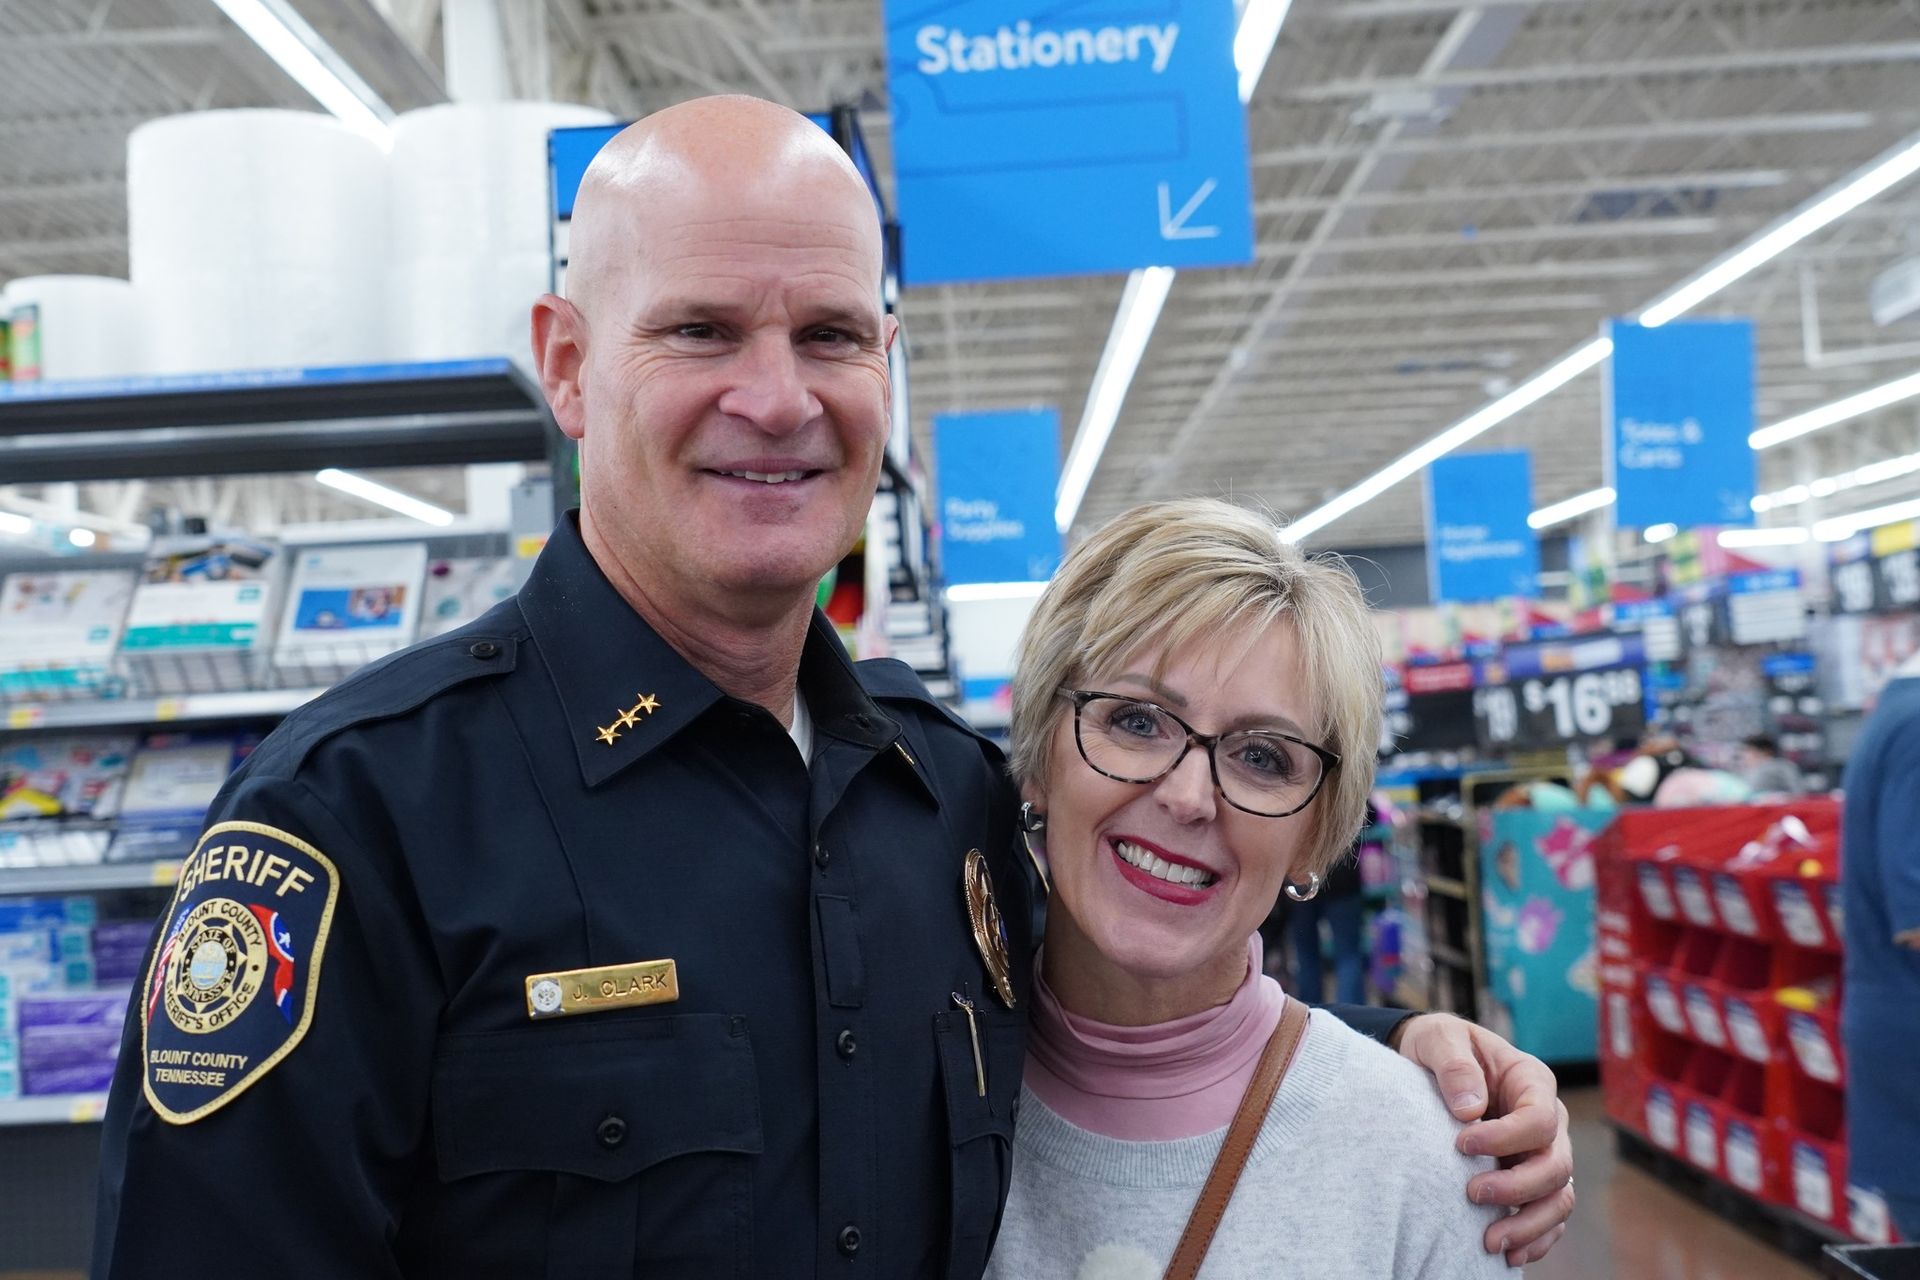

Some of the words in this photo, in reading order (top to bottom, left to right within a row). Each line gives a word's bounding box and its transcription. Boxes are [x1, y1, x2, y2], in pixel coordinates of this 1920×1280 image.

[915, 20, 1180, 75] Stationery
[180, 845, 315, 902] SHERIFF
[178, 901, 217, 943] BLOUNT
[220, 902, 262, 946] COUNTY
[191, 928, 222, 953] STATE
[223, 936, 236, 956] OF
[165, 978, 204, 1031] SHERIFF'S
[208, 981, 256, 1027] OFFICE
[572, 983, 589, 1001] J.
[600, 973, 669, 998] CLARK
[150, 1049, 192, 1066] BLOUNT
[191, 1051, 249, 1070] COUNTY
[155, 1067, 226, 1087] TENNESSEE
